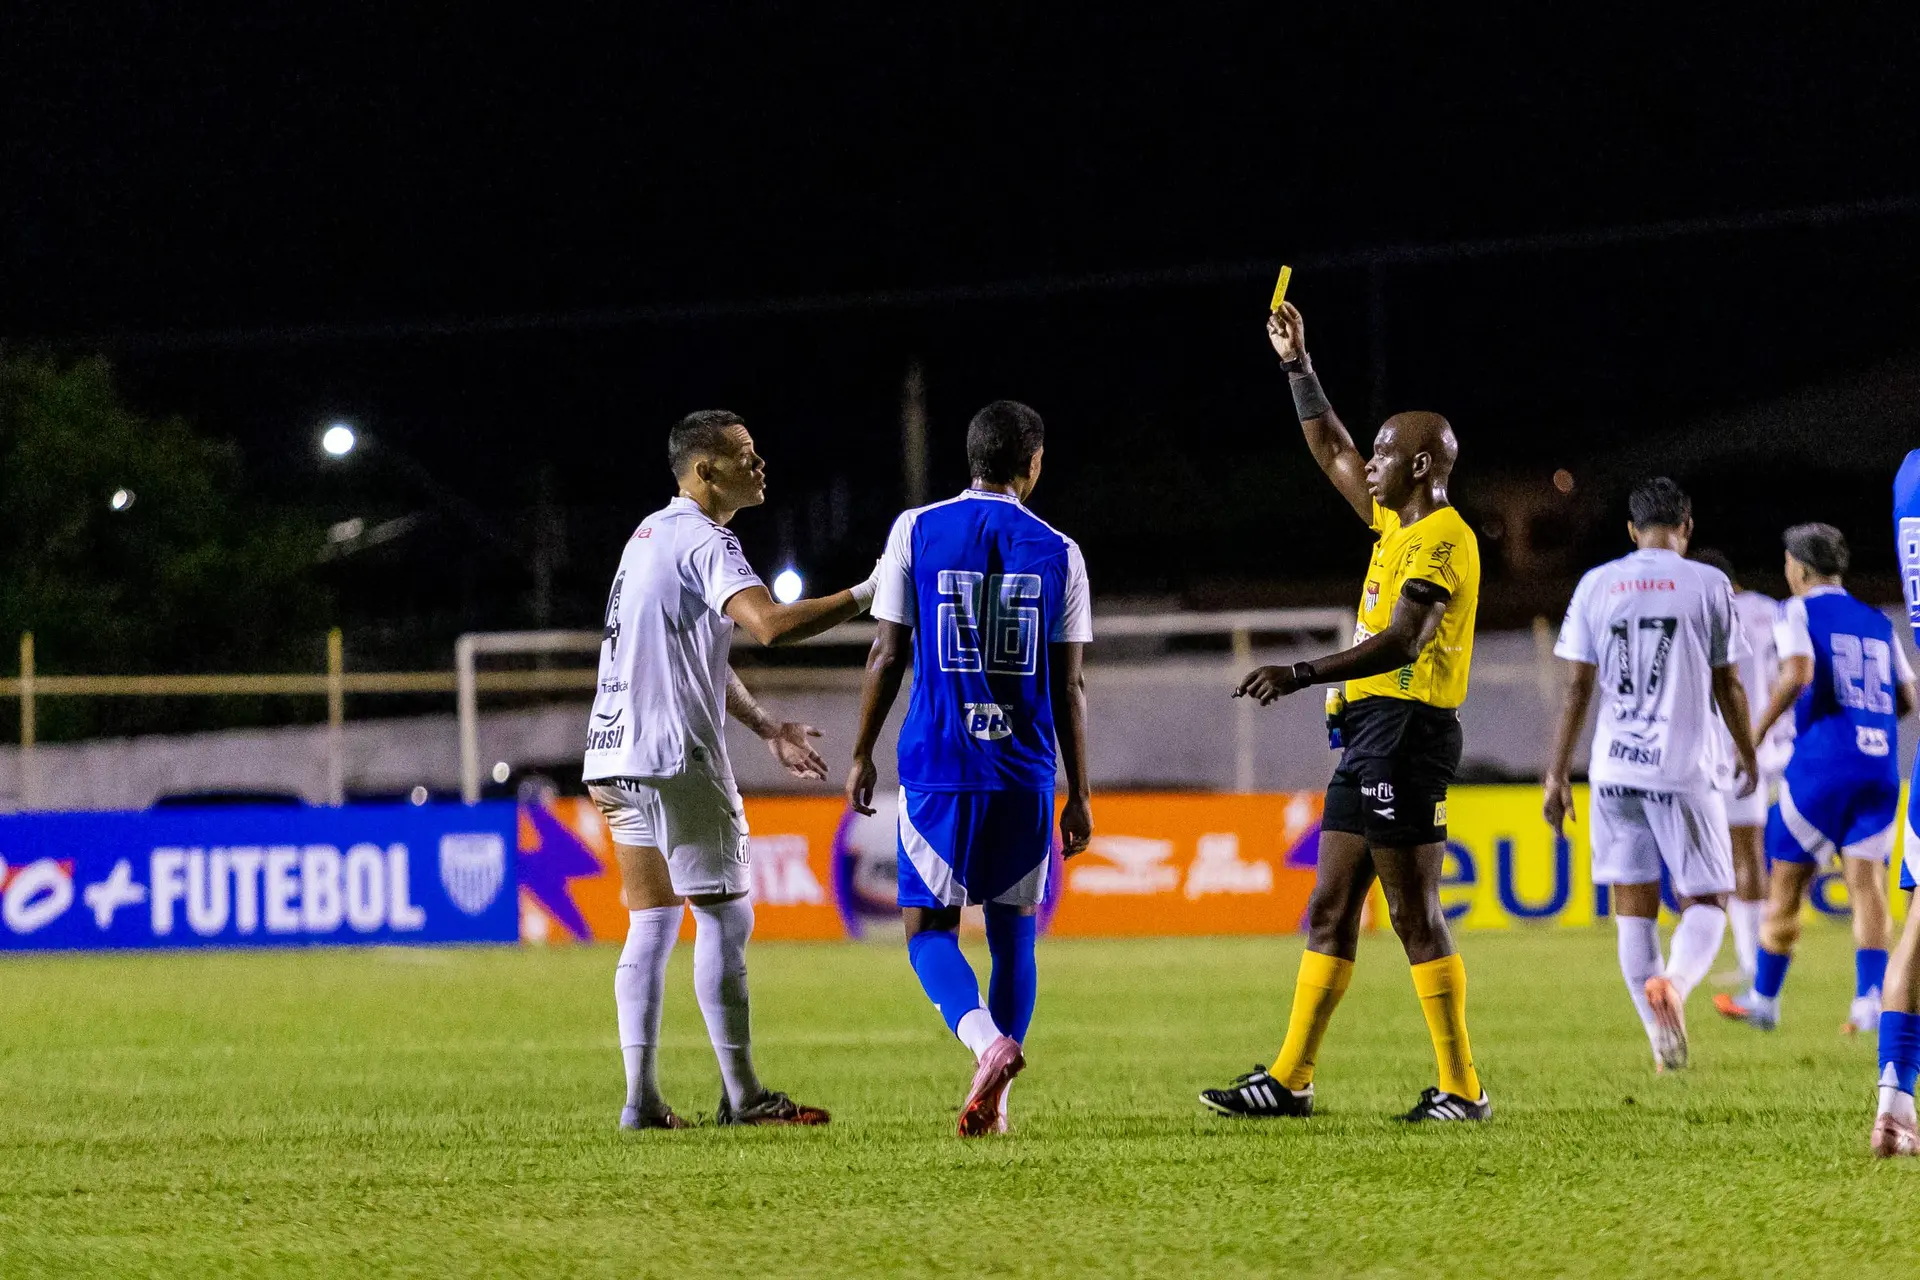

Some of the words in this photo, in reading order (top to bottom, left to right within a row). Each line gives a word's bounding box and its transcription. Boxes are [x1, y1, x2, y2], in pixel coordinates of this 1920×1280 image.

[937, 569, 1042, 676] 26
[1611, 617, 1677, 695] 17
[1830, 632, 1894, 715] 22
[1378, 782, 1394, 798] fit
[1609, 739, 1662, 767] Brasil
[150, 843, 427, 935] FUTEBOL
